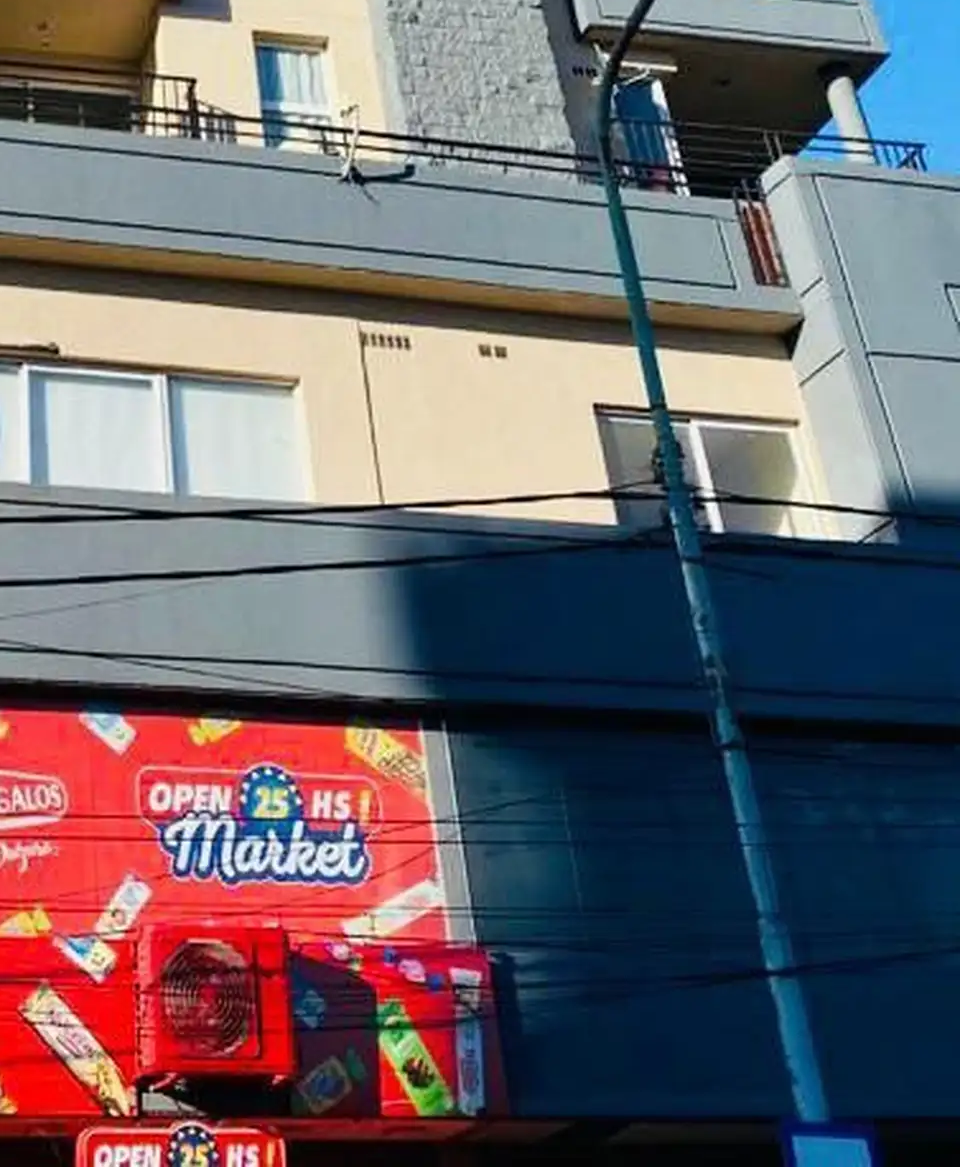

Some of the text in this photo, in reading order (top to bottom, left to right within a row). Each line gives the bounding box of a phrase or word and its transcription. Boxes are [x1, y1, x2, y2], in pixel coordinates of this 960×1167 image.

[149, 783, 232, 812] OPEN
[253, 786, 290, 819] 25
[164, 813, 366, 878] Market
[93, 1144, 161, 1167] OPEN
